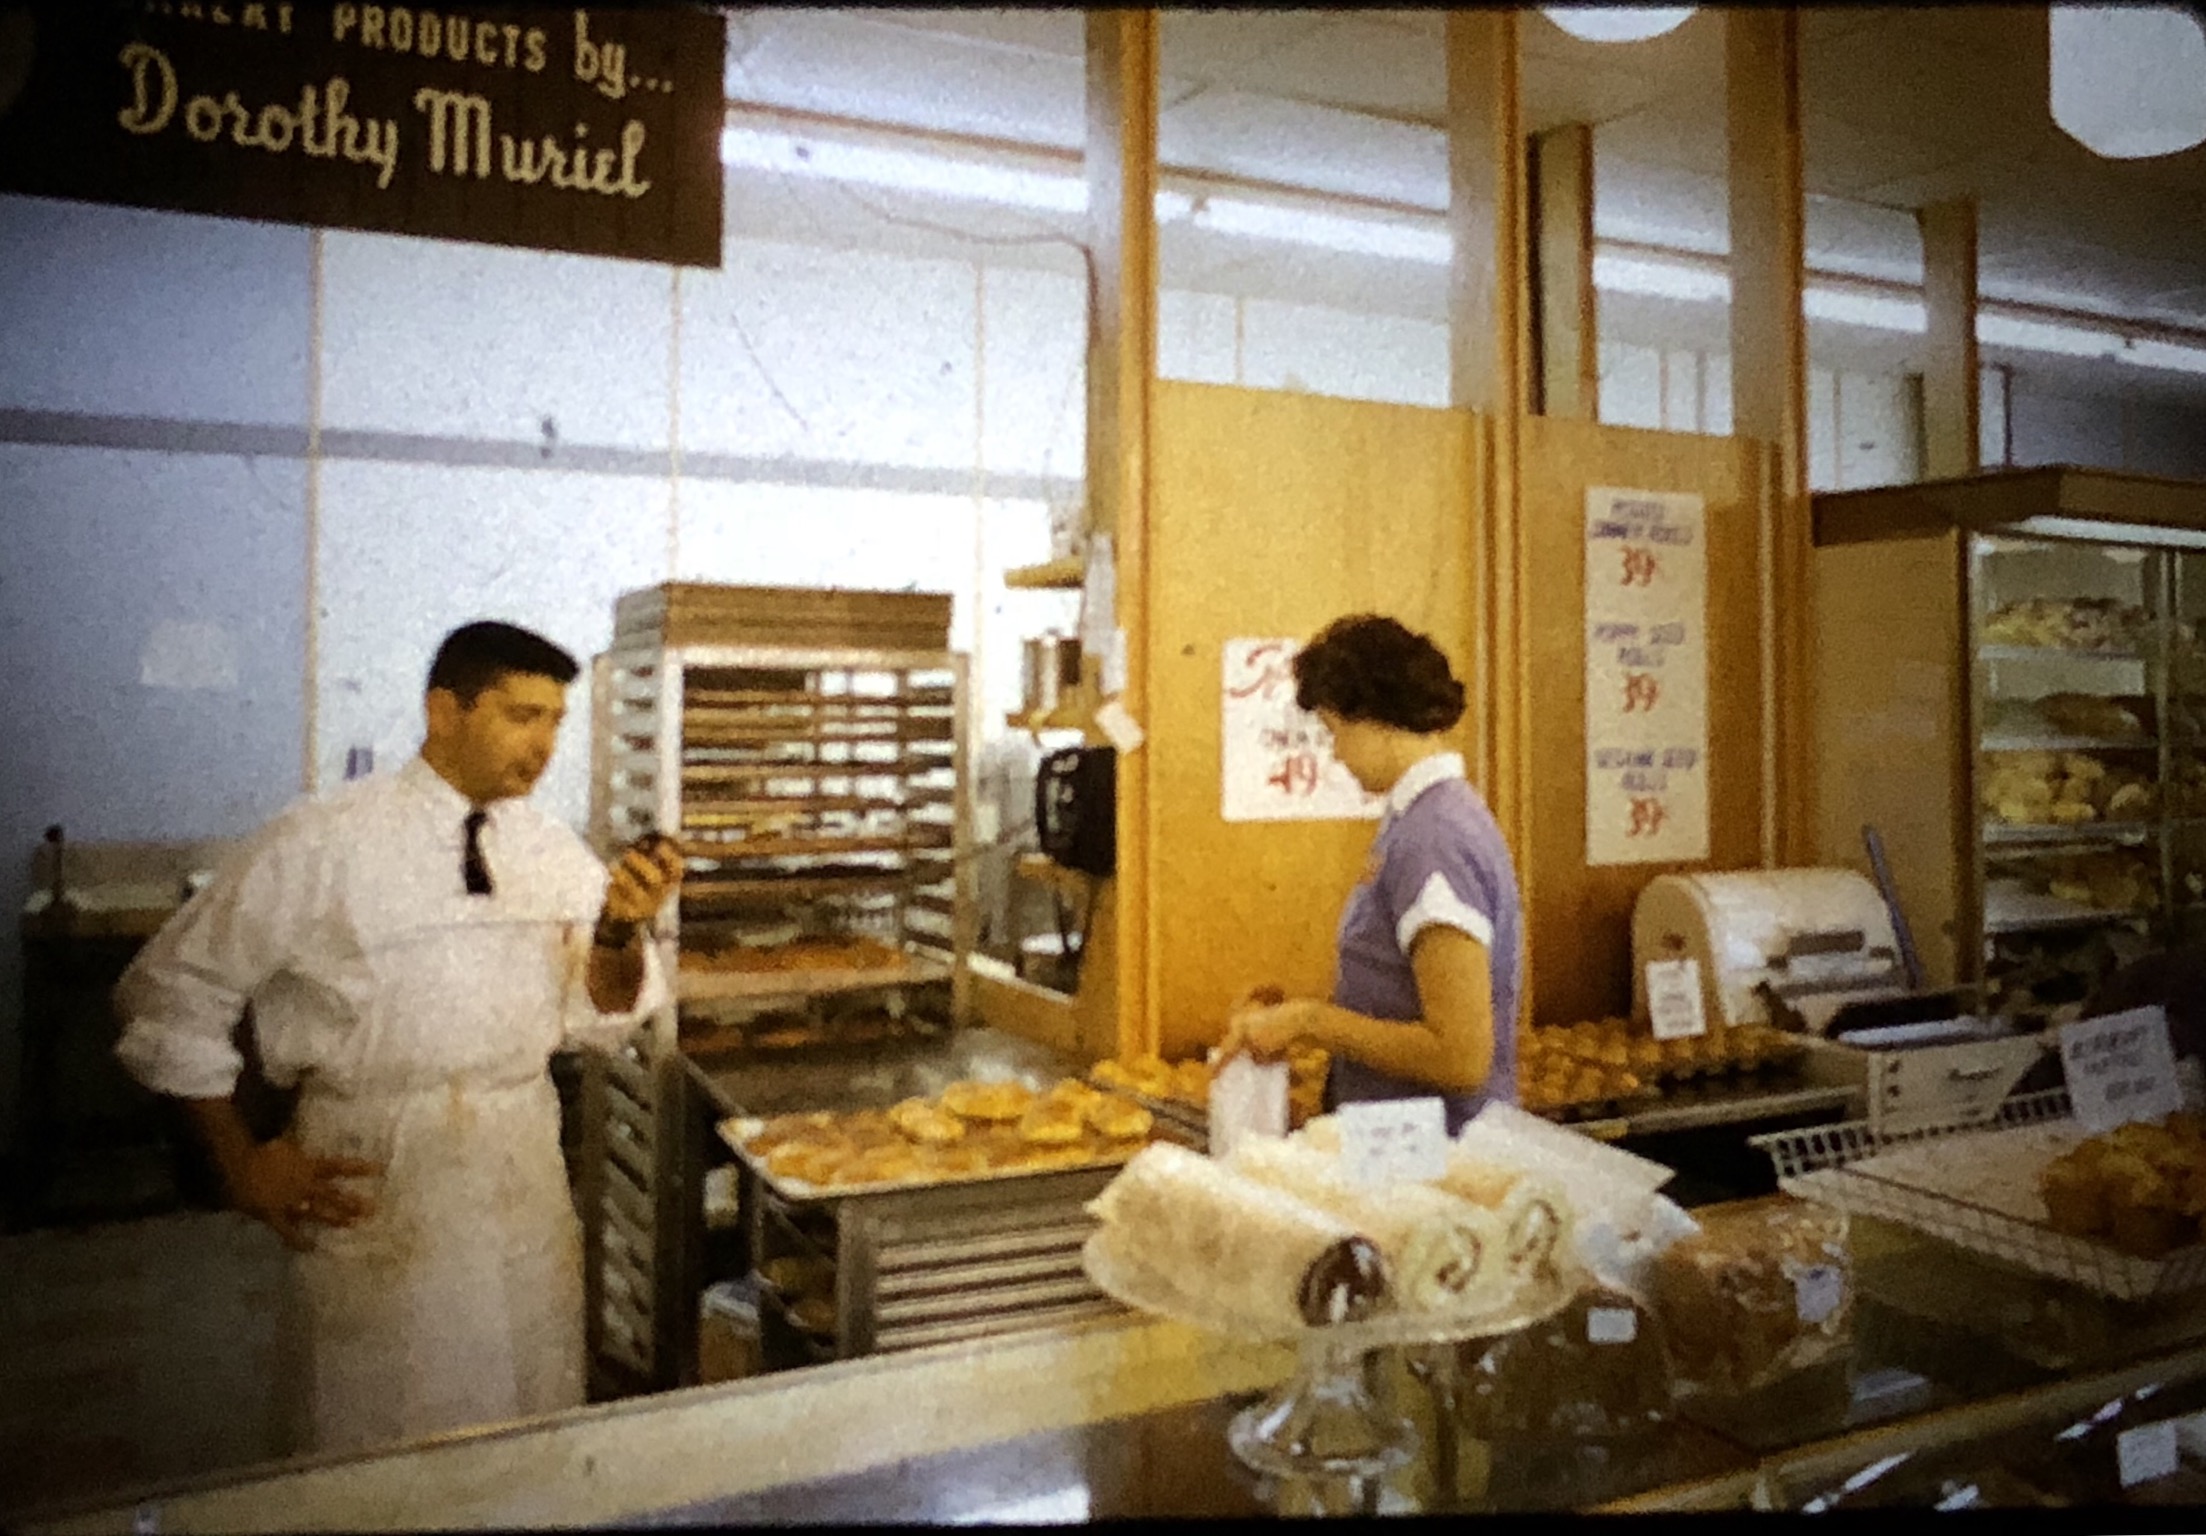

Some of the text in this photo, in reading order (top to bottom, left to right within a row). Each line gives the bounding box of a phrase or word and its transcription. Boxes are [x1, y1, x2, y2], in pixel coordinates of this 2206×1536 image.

[332, 3, 547, 73] PRODUCTS
[118, 42, 652, 198] Dorothy Muriel
